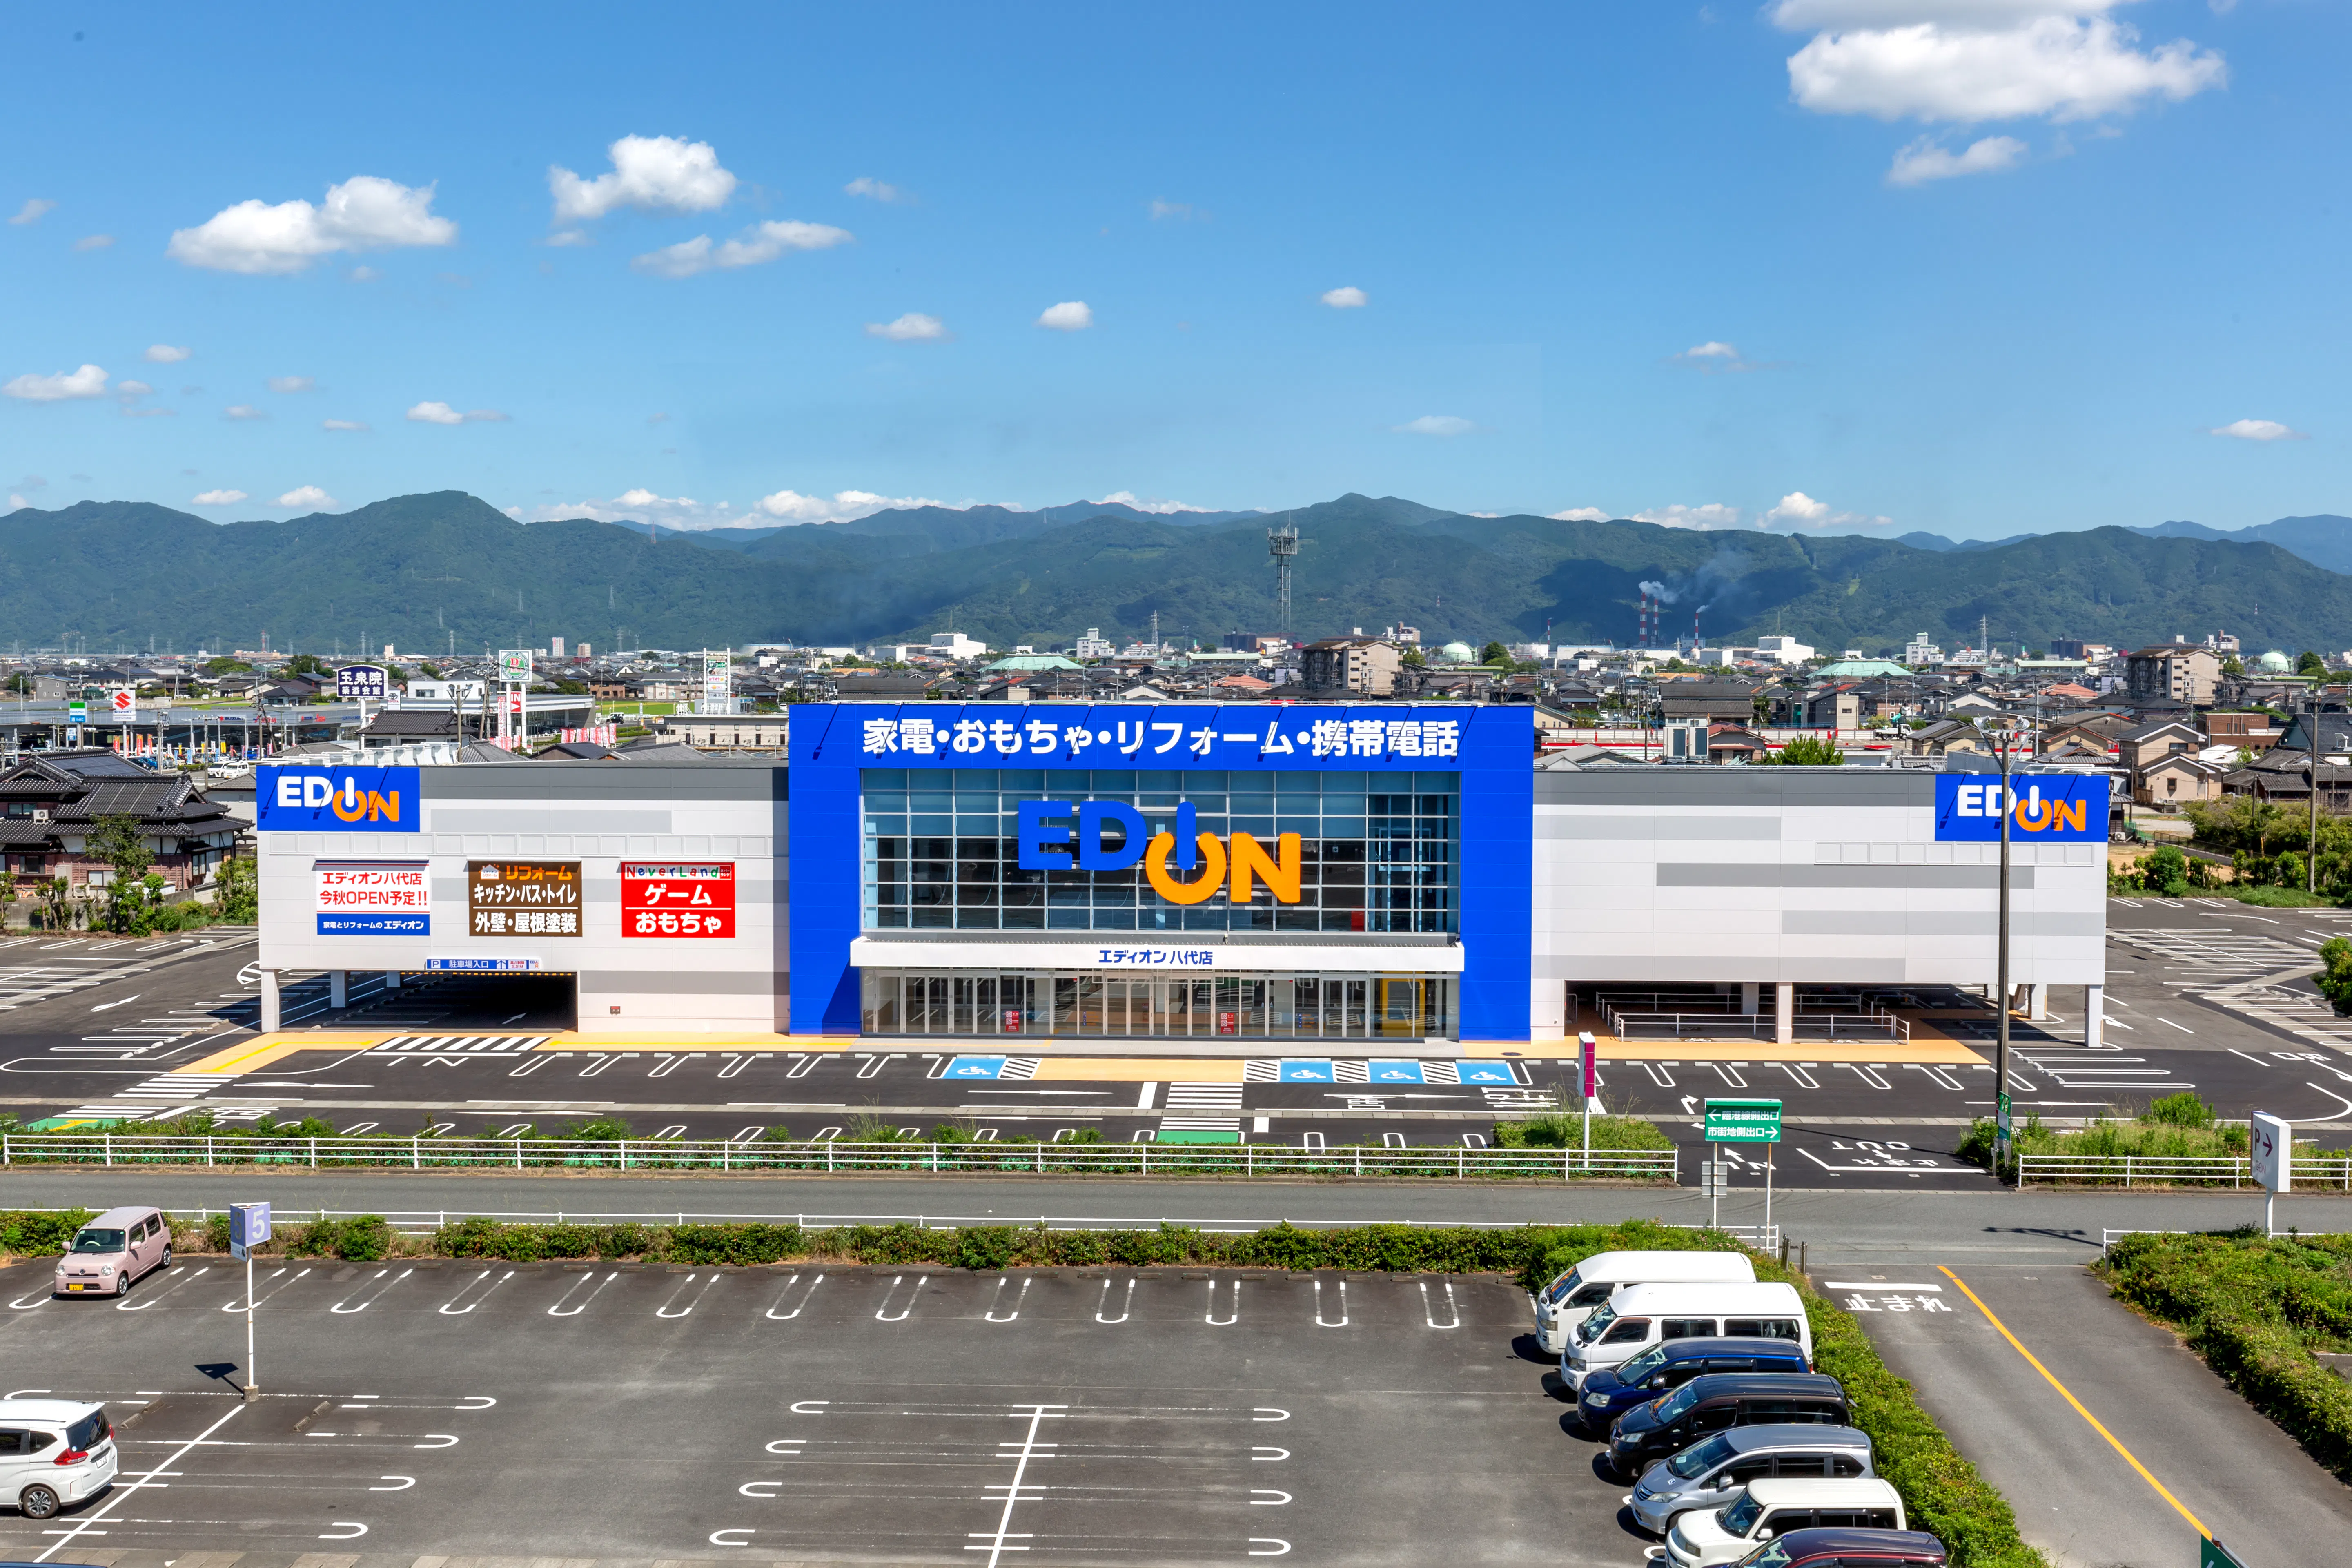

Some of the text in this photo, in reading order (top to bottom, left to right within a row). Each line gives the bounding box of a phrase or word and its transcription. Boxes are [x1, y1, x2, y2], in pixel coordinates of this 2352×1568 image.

[339, 671, 383, 685] 玉泉院
[278, 776, 399, 822] EDION
[1958, 785, 2086, 832] EDION
[1018, 800, 1301, 904] EDION
[323, 872, 422, 885] エディオン八代店
[506, 865, 572, 880] リフォーム
[627, 866, 719, 878] NeverLand
[644, 884, 712, 905] ゲーム
[384, 920, 424, 929] エディオン
[636, 912, 722, 934] おもちゃ
[449, 960, 489, 968] 駐車場入口
[387, 1057, 470, 1066] IN
[1722, 1111, 1779, 1121] 臨港線側出口
[1708, 1127, 1765, 1137] 市街地側出口
[2255, 1127, 2260, 1151] P
[1832, 1141, 1911, 1150] OUT
[234, 1211, 242, 1240] 5
[252, 1209, 265, 1239] 5
[1844, 1294, 1953, 1312] 止まれ
